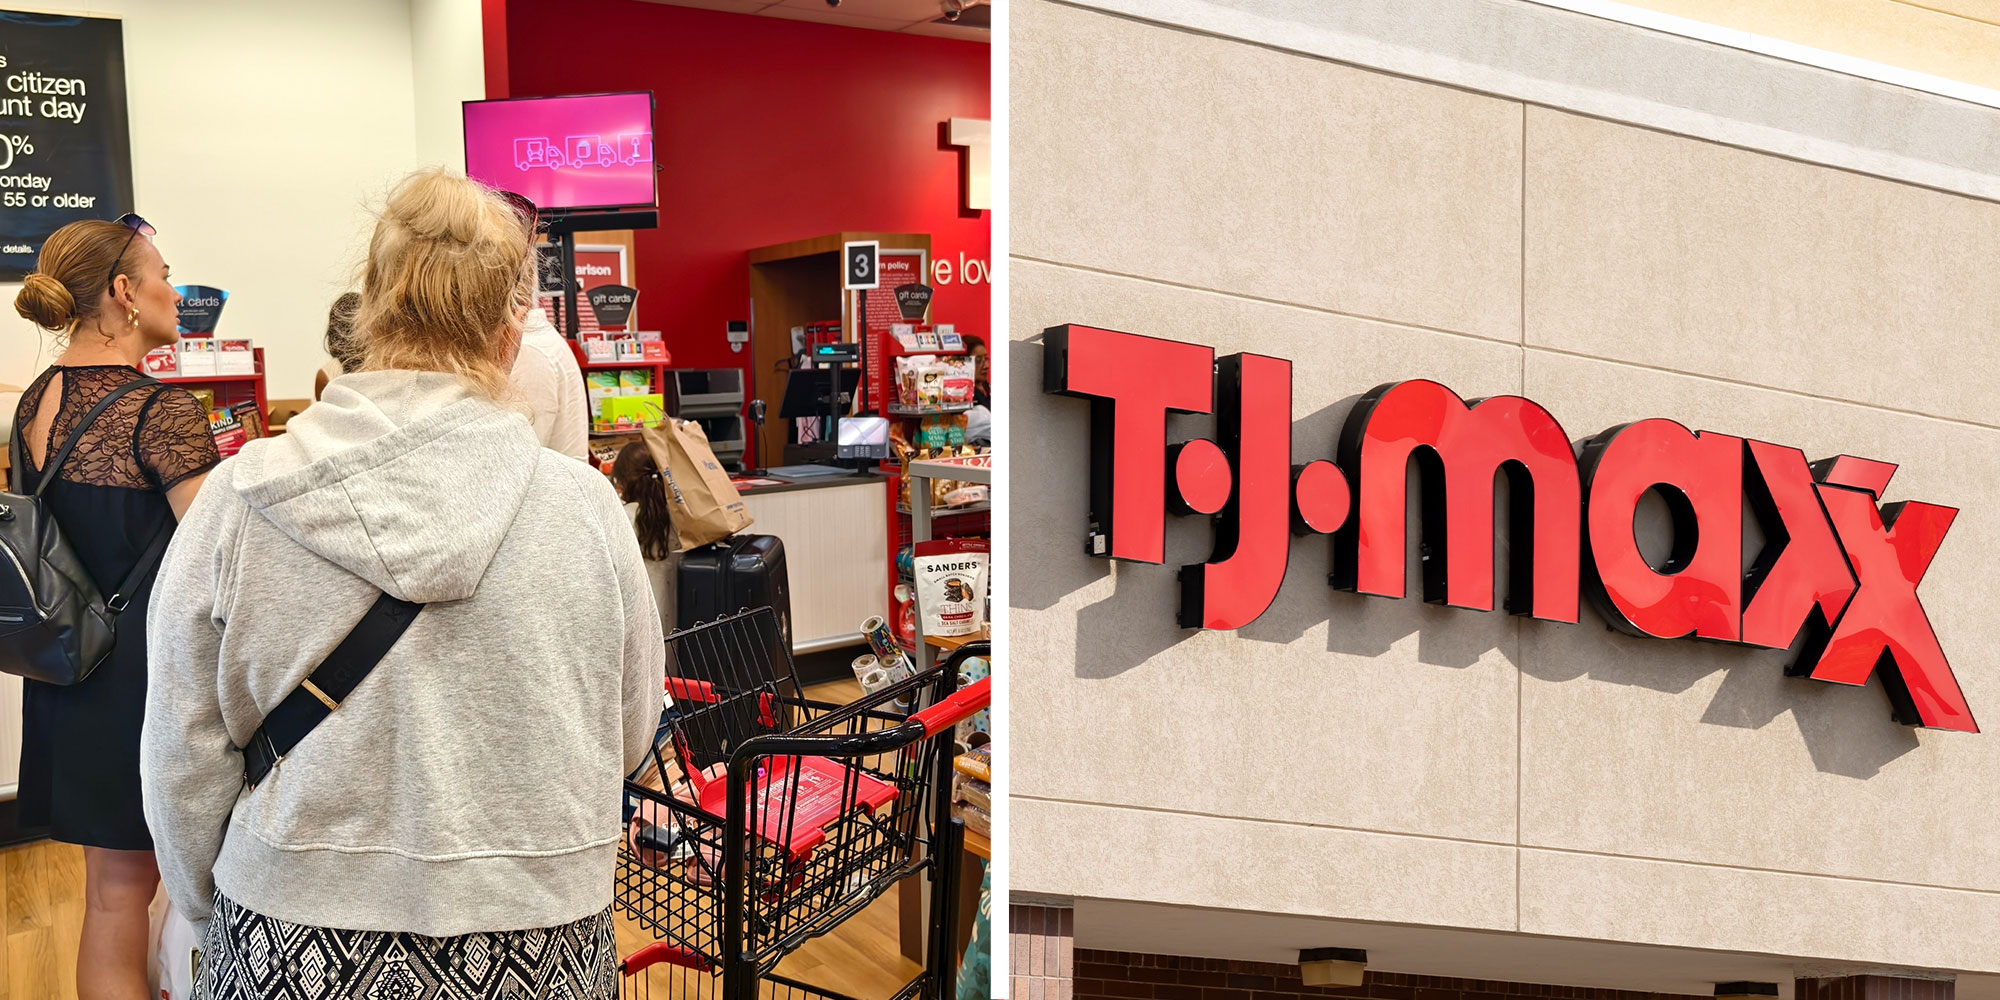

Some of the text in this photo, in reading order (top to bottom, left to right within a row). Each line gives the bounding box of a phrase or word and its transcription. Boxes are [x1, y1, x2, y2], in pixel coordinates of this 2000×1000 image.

[7, 71, 86, 96] citizen
[0, 95, 87, 124] unt day
[0, 133, 34, 170] 0%
[0, 173, 52, 191] onday
[4, 192, 96, 208] 55 or older
[3, 244, 35, 254] details.
[575, 264, 612, 276] arison
[854, 253, 869, 278] 3
[887, 261, 910, 271] policy
[959, 251, 991, 285] lov
[187, 296, 220, 307] cards
[592, 294, 632, 306] gift cards
[898, 290, 928, 301] gift cards
[211, 416, 234, 430] KIND
[927, 562, 977, 573] SANDERS
[941, 602, 973, 613] THINS
